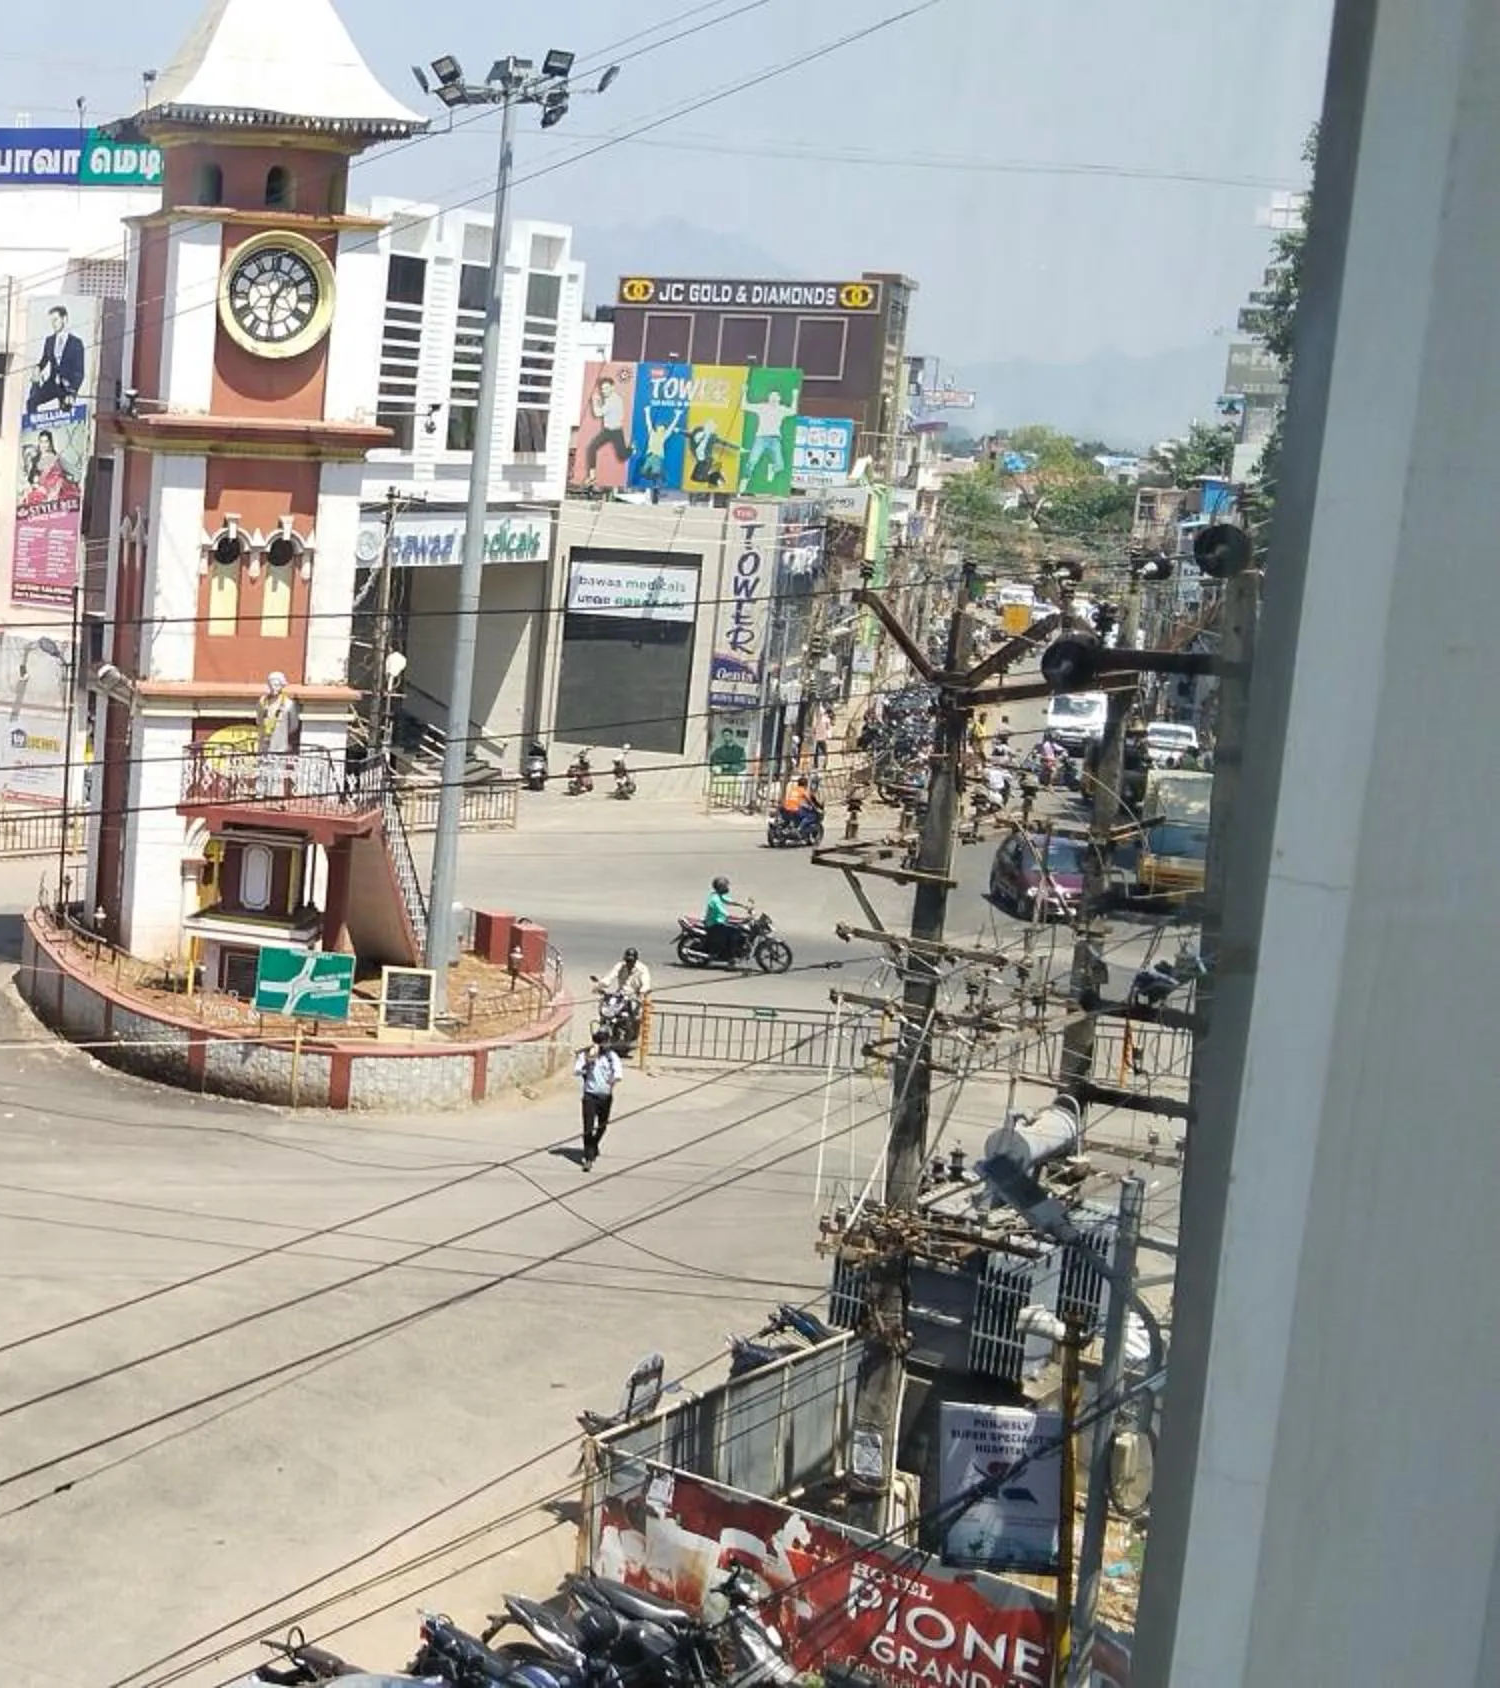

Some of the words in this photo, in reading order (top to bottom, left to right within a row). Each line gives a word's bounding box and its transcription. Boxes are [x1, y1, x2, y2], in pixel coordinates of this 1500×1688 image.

[89, 146, 165, 181] மெடி
[659, 283, 684, 302] JC
[689, 284, 733, 303] GOLD
[735, 285, 747, 304] &
[751, 286, 837, 306] DIAMONDS
[392, 534, 454, 560] awaa
[726, 523, 765, 655] TOWER
[852, 1561, 933, 1601] HOTEL
